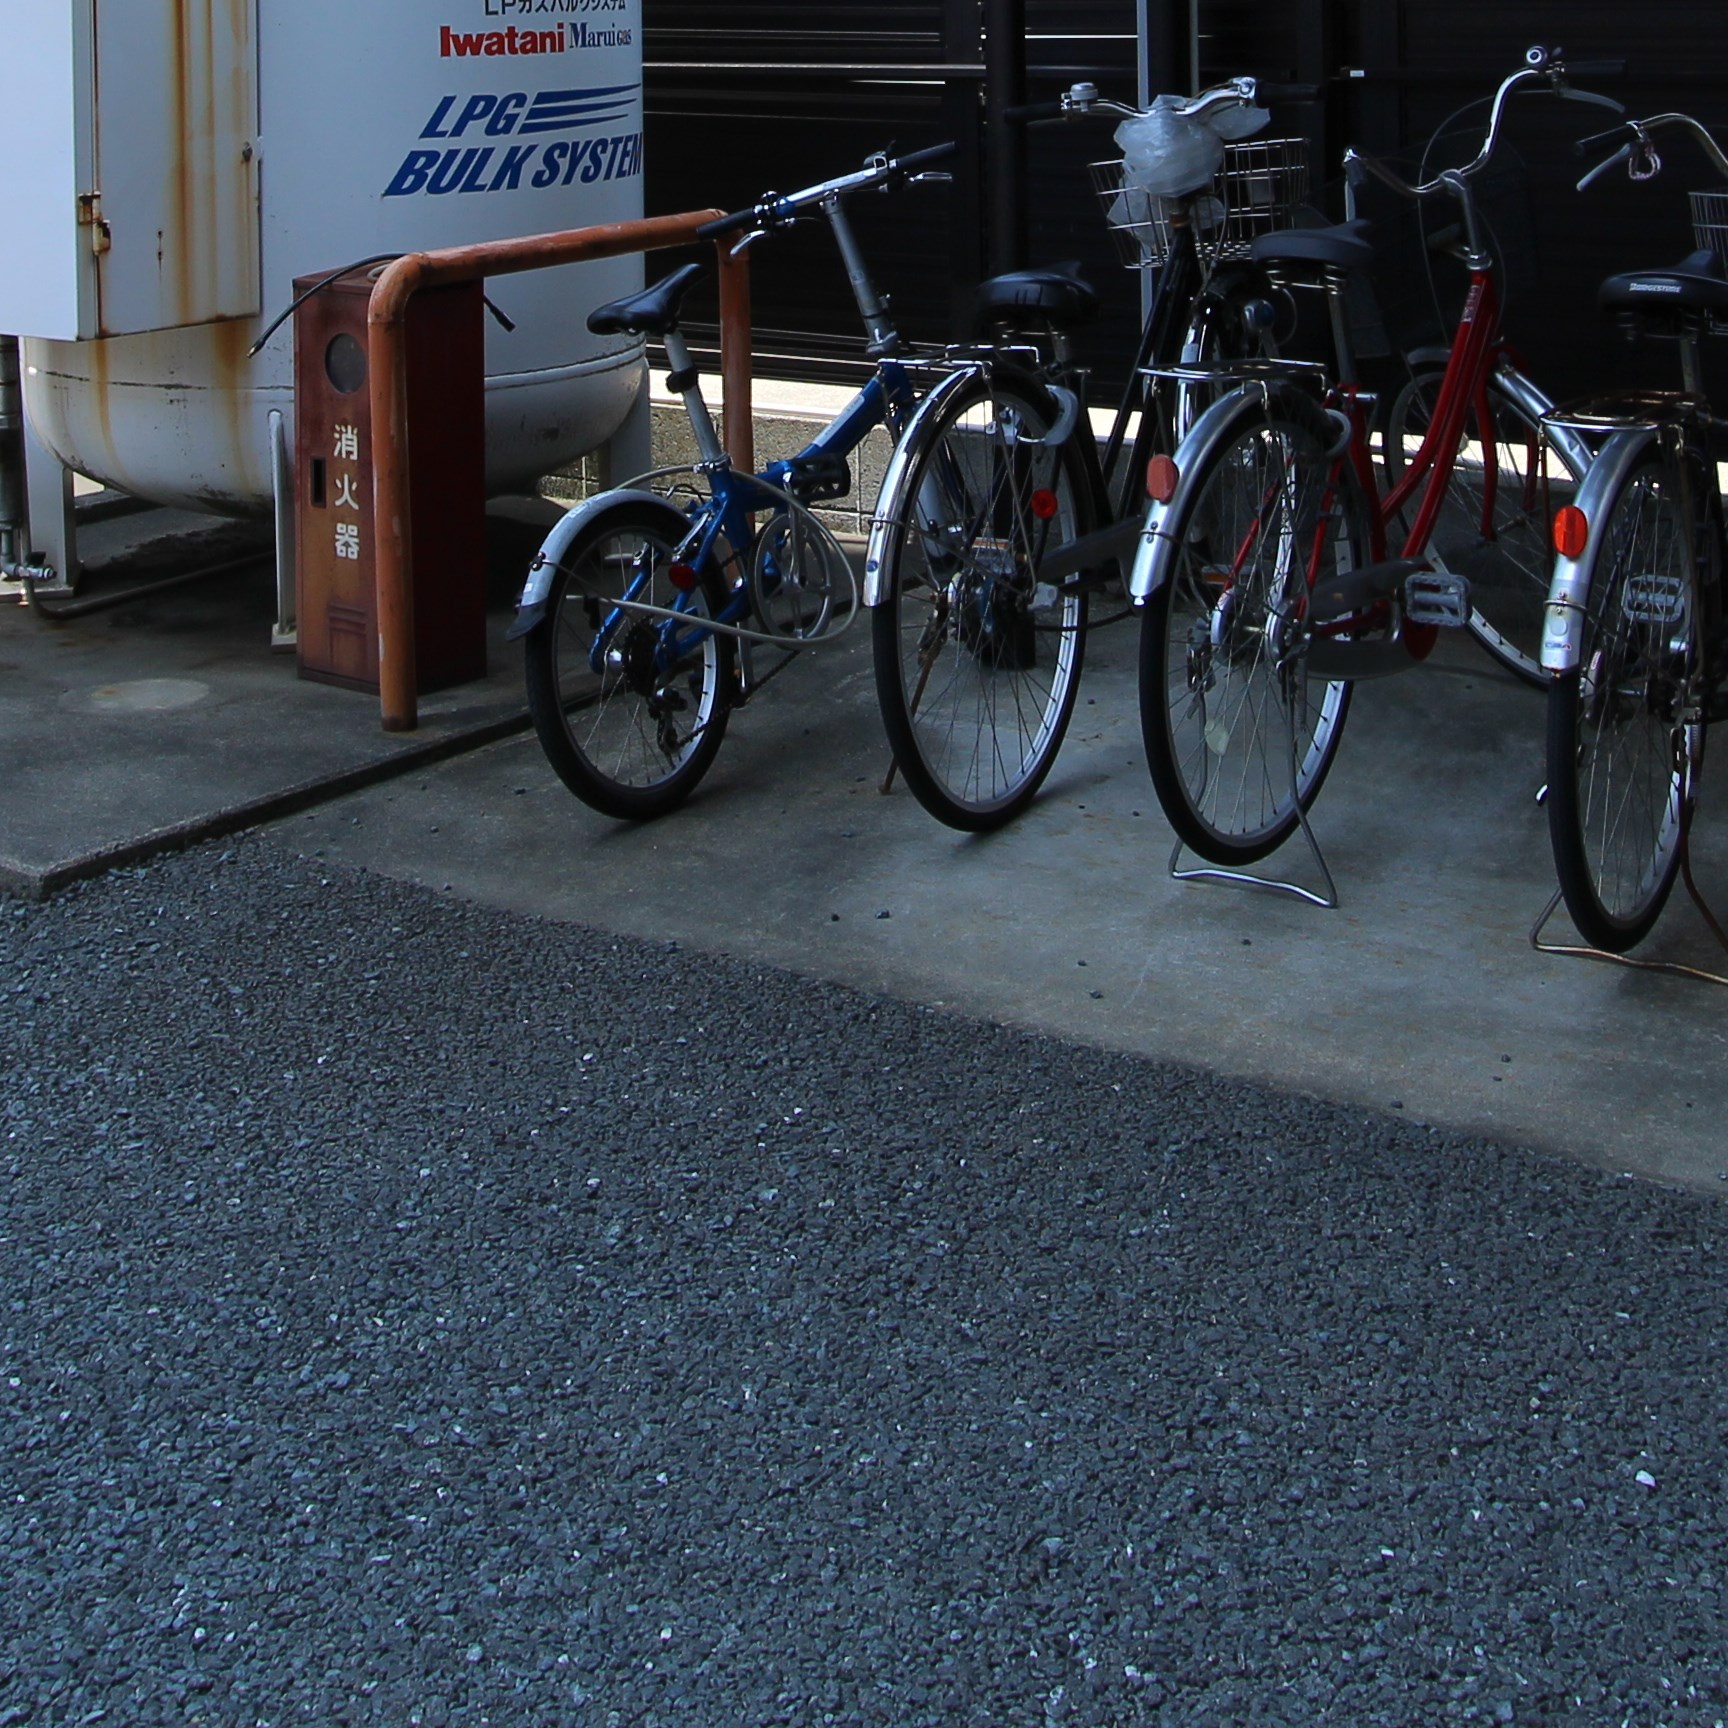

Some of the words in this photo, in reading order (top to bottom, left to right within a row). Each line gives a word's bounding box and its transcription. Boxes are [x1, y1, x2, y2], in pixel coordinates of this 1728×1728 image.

[439, 22, 565, 58] Iwatani
[418, 92, 528, 139] LPG
[381, 144, 539, 197] BULK
[531, 132, 643, 189] SYSTEM
[332, 423, 360, 561] 消火器
